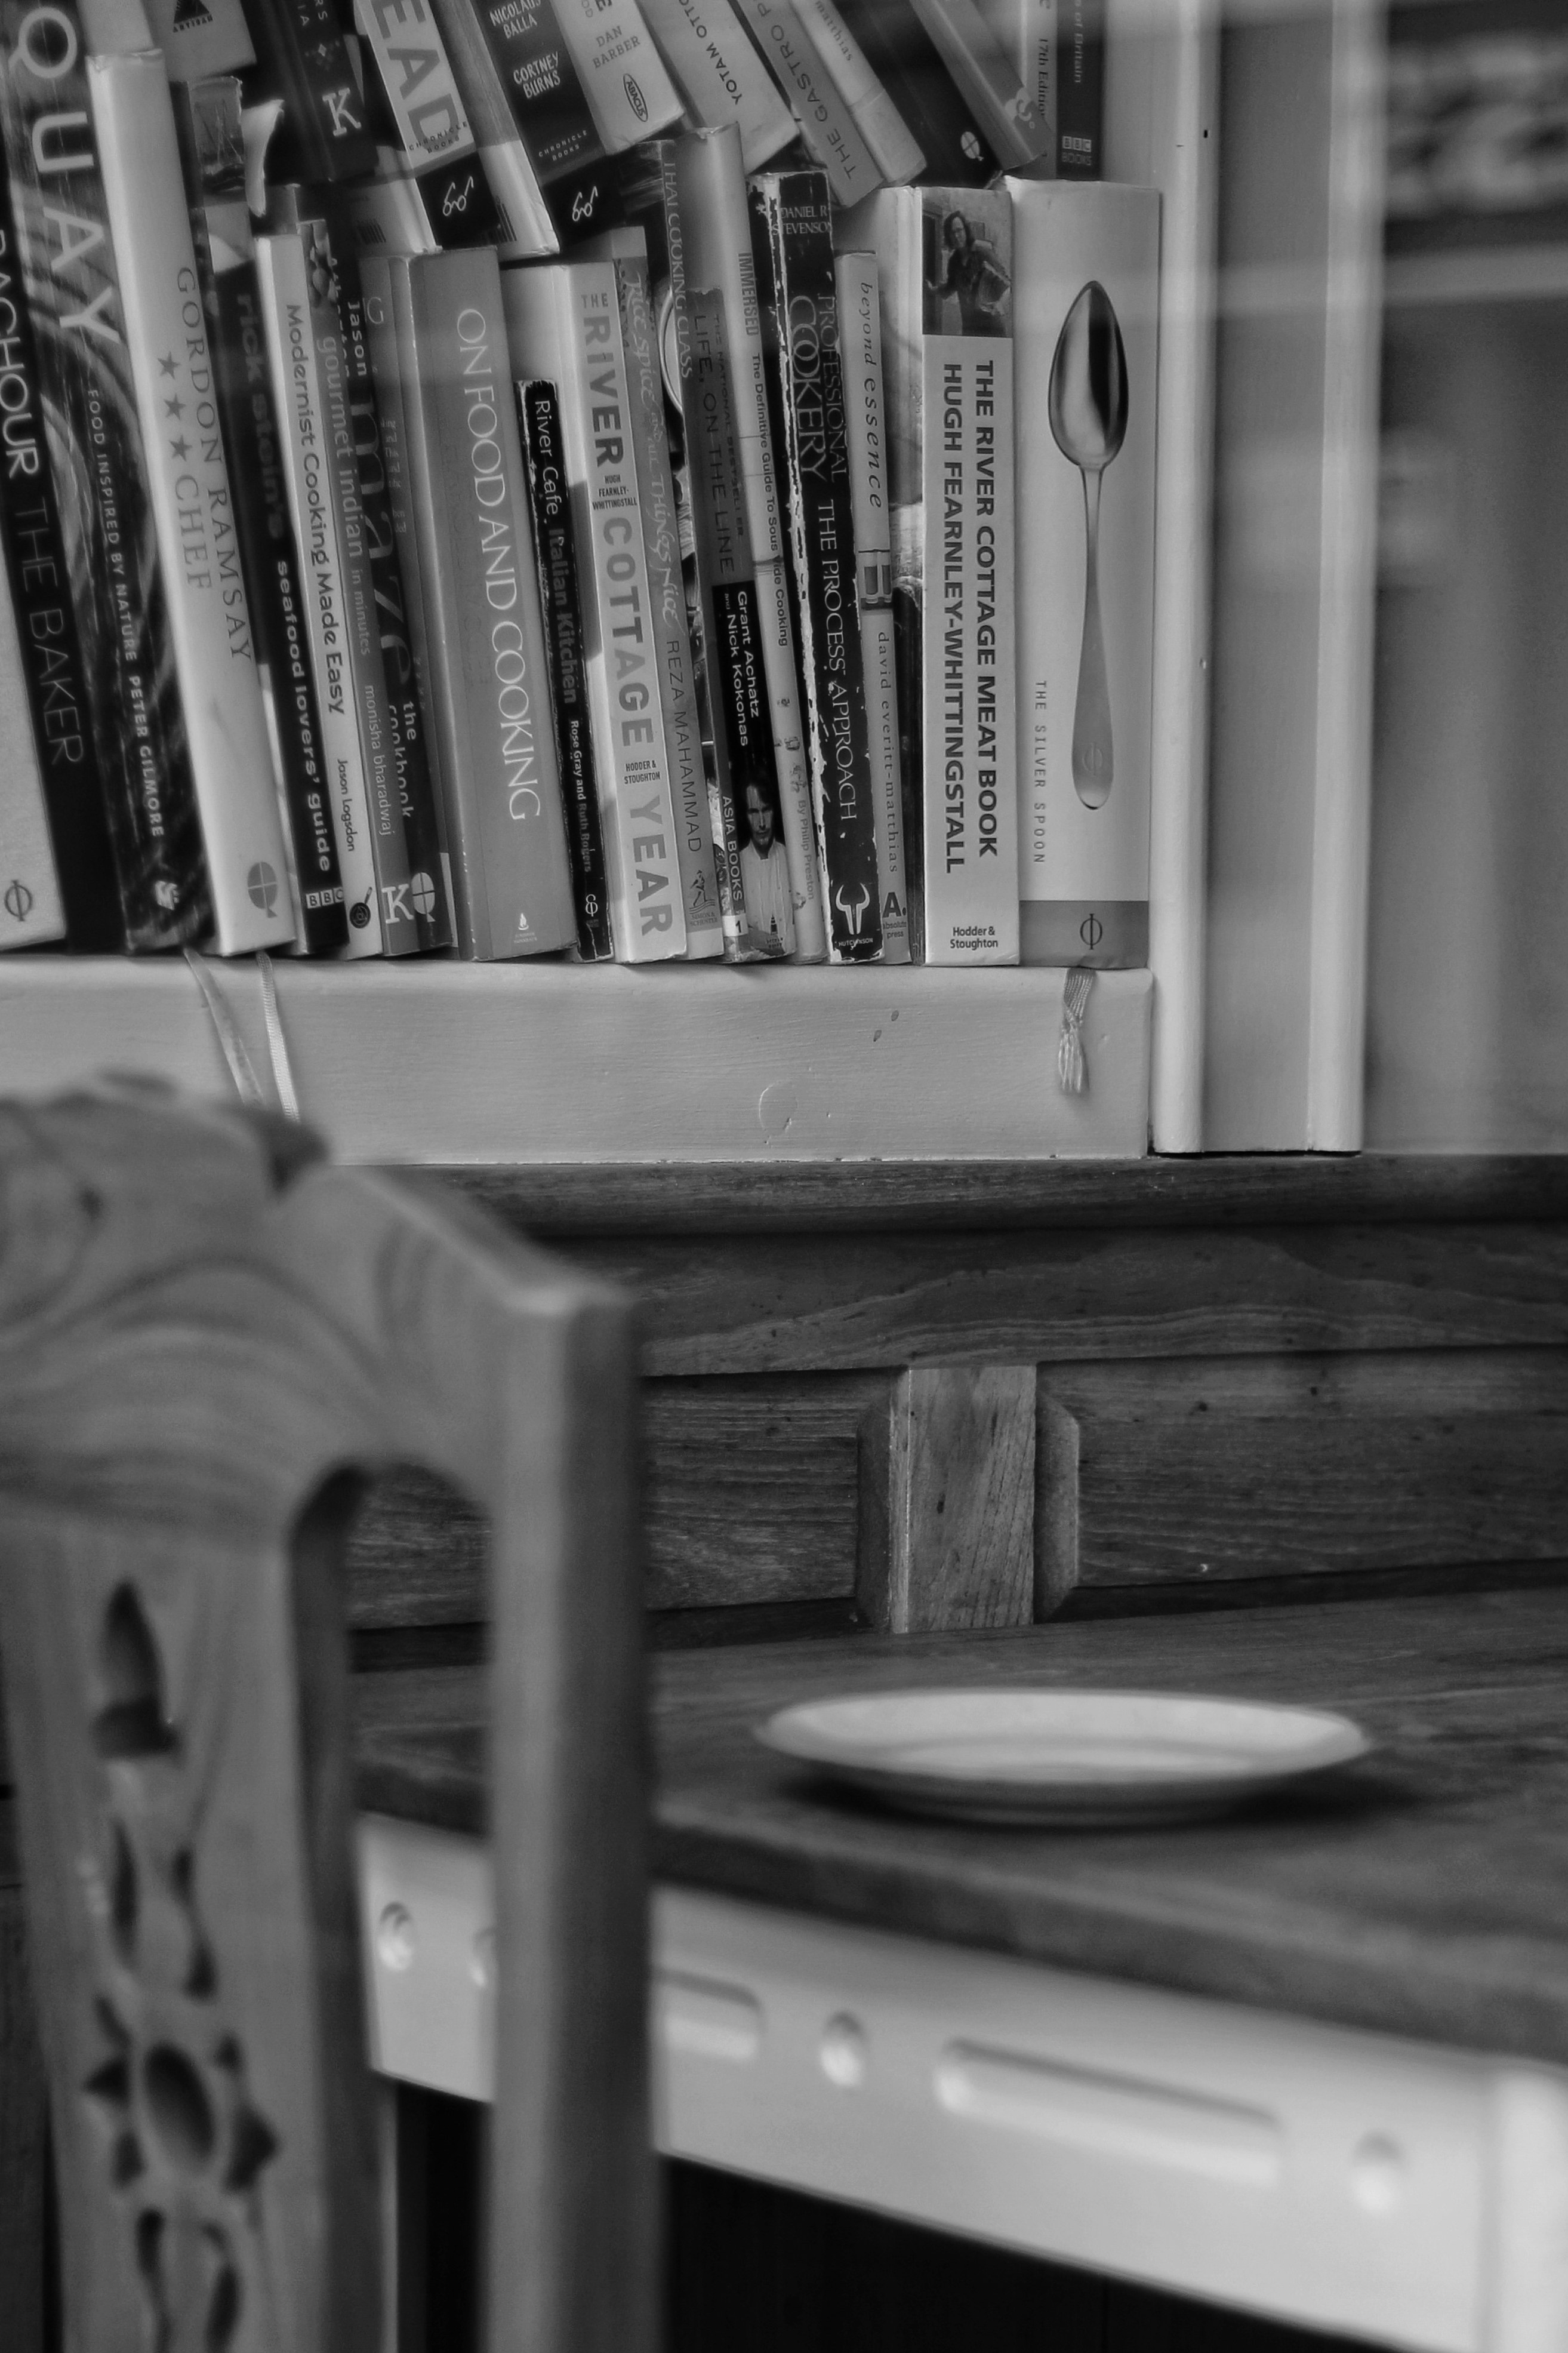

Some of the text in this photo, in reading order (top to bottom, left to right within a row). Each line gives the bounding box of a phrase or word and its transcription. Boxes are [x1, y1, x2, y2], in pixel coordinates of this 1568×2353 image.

[503, 13, 537, 39] BALLA
[593, 35, 640, 69] BARBER
[595, 24, 623, 48] DAN
[816, 2, 854, 62] matthias
[1038, 38, 1049, 66] 17th
[513, 51, 559, 85] CORTNEY
[522, 70, 561, 99] BURNS
[624, 78, 647, 119] ABACUS
[706, 42, 743, 105] YOTAM
[770, 23, 828, 123] GASTRO
[322, 87, 362, 139] K
[409, 121, 467, 151] CHRONICLE
[427, 136, 460, 153] BOOKS
[538, 129, 588, 157] CHRONICLE
[8, 7, 122, 344] QUAY
[552, 143, 581, 162] BOOKS
[826, 128, 854, 180] THE
[780, 205, 820, 219] DANIEL
[667, 213, 687, 310] COOKING
[581, 293, 608, 309] THE
[348, 301, 368, 377] Jason
[676, 315, 693, 379] CLASS
[316, 336, 353, 459] gourmet
[583, 316, 624, 468] RIVER
[789, 295, 827, 482] COOKERY
[818, 292, 848, 483] PROFESSIONAL
[859, 282, 883, 510] beyond essence
[177, 267, 253, 660] GORDON RAMSAY
[694, 315, 735, 576] LIFE, ON THE LINE
[717, 351, 732, 428] NATIONAL
[726, 436, 744, 536] BESTSELLER
[738, 252, 788, 647] IMMERSED The Definitive Guide To Sous Vide Cooking
[287, 304, 346, 715] Modernist Cooking Made Easy
[592, 498, 637, 512] WHITTINGSTALL
[598, 486, 629, 497] FEARNLEY-
[604, 475, 621, 484] HUGH
[15, 496, 59, 593] THE
[175, 475, 213, 589] CHEF
[339, 469, 365, 558] indian
[238, 294, 264, 383] rick
[276, 559, 305, 679] seafood
[295, 685, 320, 783] lovers'
[308, 793, 331, 872] guide
[351, 568, 363, 585] in
[456, 308, 541, 820] ON FOOD AND COOKING
[535, 401, 577, 705] River Cafe Italian Kitchen
[88, 389, 165, 837] FOOD INSPIRED BY NATURE PETER GILMORE
[353, 590, 371, 656] minutes
[602, 516, 654, 747] COTTAGE
[727, 614, 740, 657] Nick
[943, 363, 966, 875] HUGH FEARNLEY-WHITTINGSTALL
[975, 359, 999, 859] THE RIVER COTTAGE MEAT BOOK
[29, 608, 84, 765] BAKER
[738, 591, 759, 719] Grant Achatz
[819, 499, 857, 821] THE PROCESS APPROACH
[403, 701, 417, 741] the
[569, 720, 580, 748] Rose
[732, 664, 749, 746] Kokonas
[364, 685, 397, 836] monisha bharadwaj
[571, 752, 584, 779] Gray
[624, 771, 661, 785] STOUGHTON
[625, 760, 657, 772] HODDER &
[667, 639, 702, 853] REZA MAHAMMAD
[878, 630, 899, 873] david everitt-matthias
[1034, 680, 1048, 863] THE SILVER SPOON
[337, 759, 358, 852] Jason Logsdon
[577, 780, 586, 800] and
[577, 803, 589, 830] Ruth
[630, 795, 673, 936] YEAR
[722, 796, 743, 902] ASIA BOOKS
[797, 799, 815, 900] By Philip Preston
[307, 890, 344, 909] BBC
[381, 884, 414, 924] K
[735, 919, 743, 934] 1
[953, 926, 996, 937] Hodder &
[836, 937, 874, 948] HUTCHINSON
[886, 930, 905, 940] press
[950, 937, 999, 950] Stoughton
